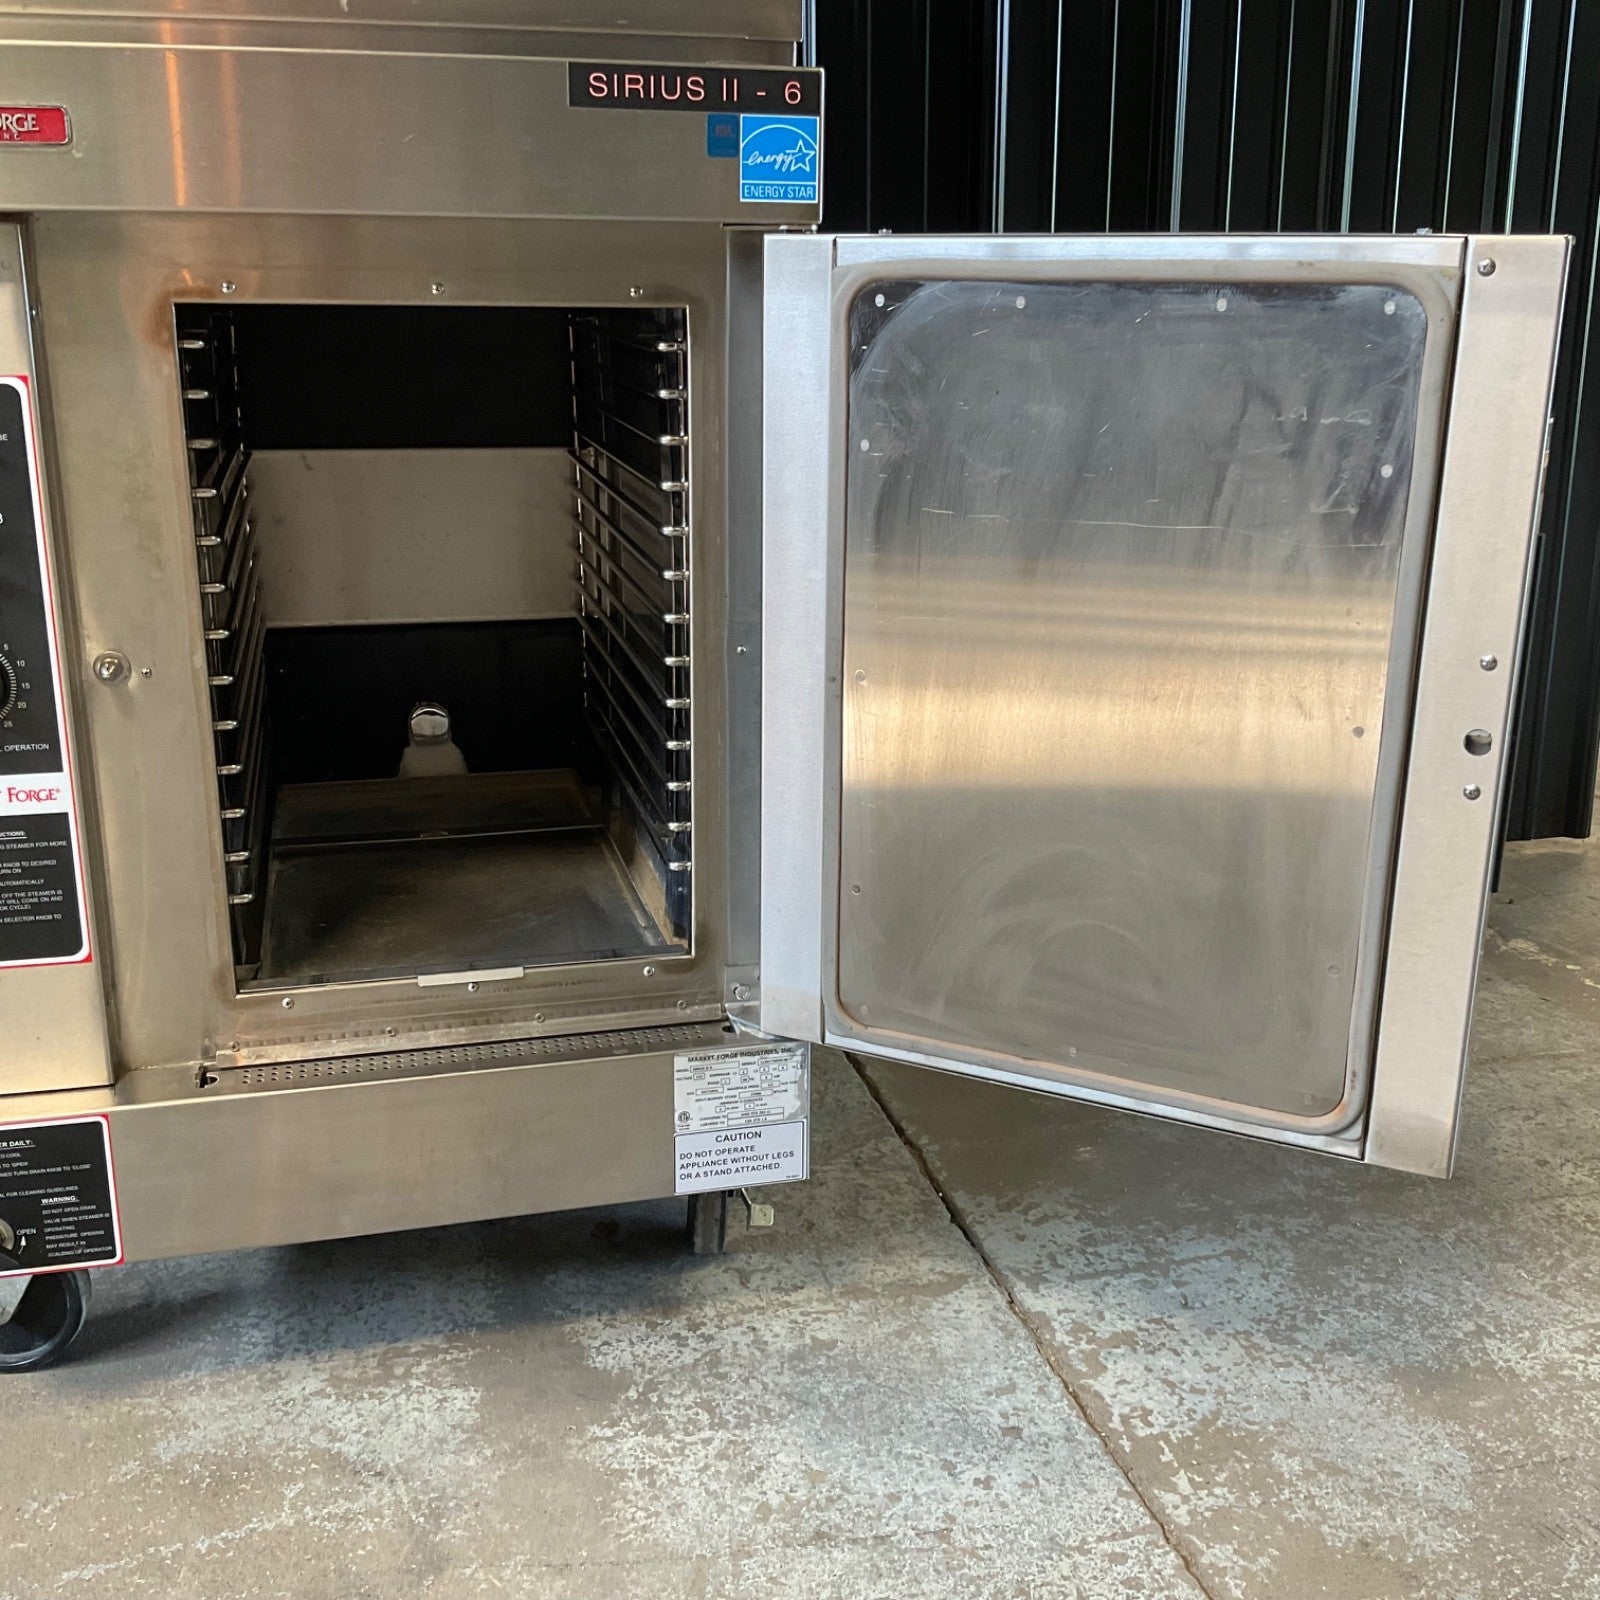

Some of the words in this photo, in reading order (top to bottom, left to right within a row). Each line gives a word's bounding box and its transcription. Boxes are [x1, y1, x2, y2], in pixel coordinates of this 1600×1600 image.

[589, 72, 705, 101] SIRIUS
[723, 78, 738, 102] II
[784, 81, 801, 105] 6
[744, 150, 795, 172] energy
[744, 185, 785, 198] ENERGY
[787, 186, 814, 198] STAR
[3, 643, 9, 651] 5
[17, 701, 27, 709] 20
[3, 720, 13, 728] 25
[4, 743, 50, 752] OPERATION
[687, 1054, 715, 1063] MARKET
[716, 1052, 738, 1060] FORGE
[715, 1131, 762, 1143] CAUTION
[680, 1152, 693, 1160] DO
[694, 1150, 712, 1158] NOT
[715, 1145, 755, 1156] OPERATE
[680, 1158, 728, 1170] APPLIANCE
[730, 1153, 769, 1164] WITHOUT
[772, 1151, 794, 1160] LEGS
[703, 1168, 732, 1178] STAND
[734, 1162, 782, 1174] ATTACHED.
[16, 1228, 36, 1236] OPEN
